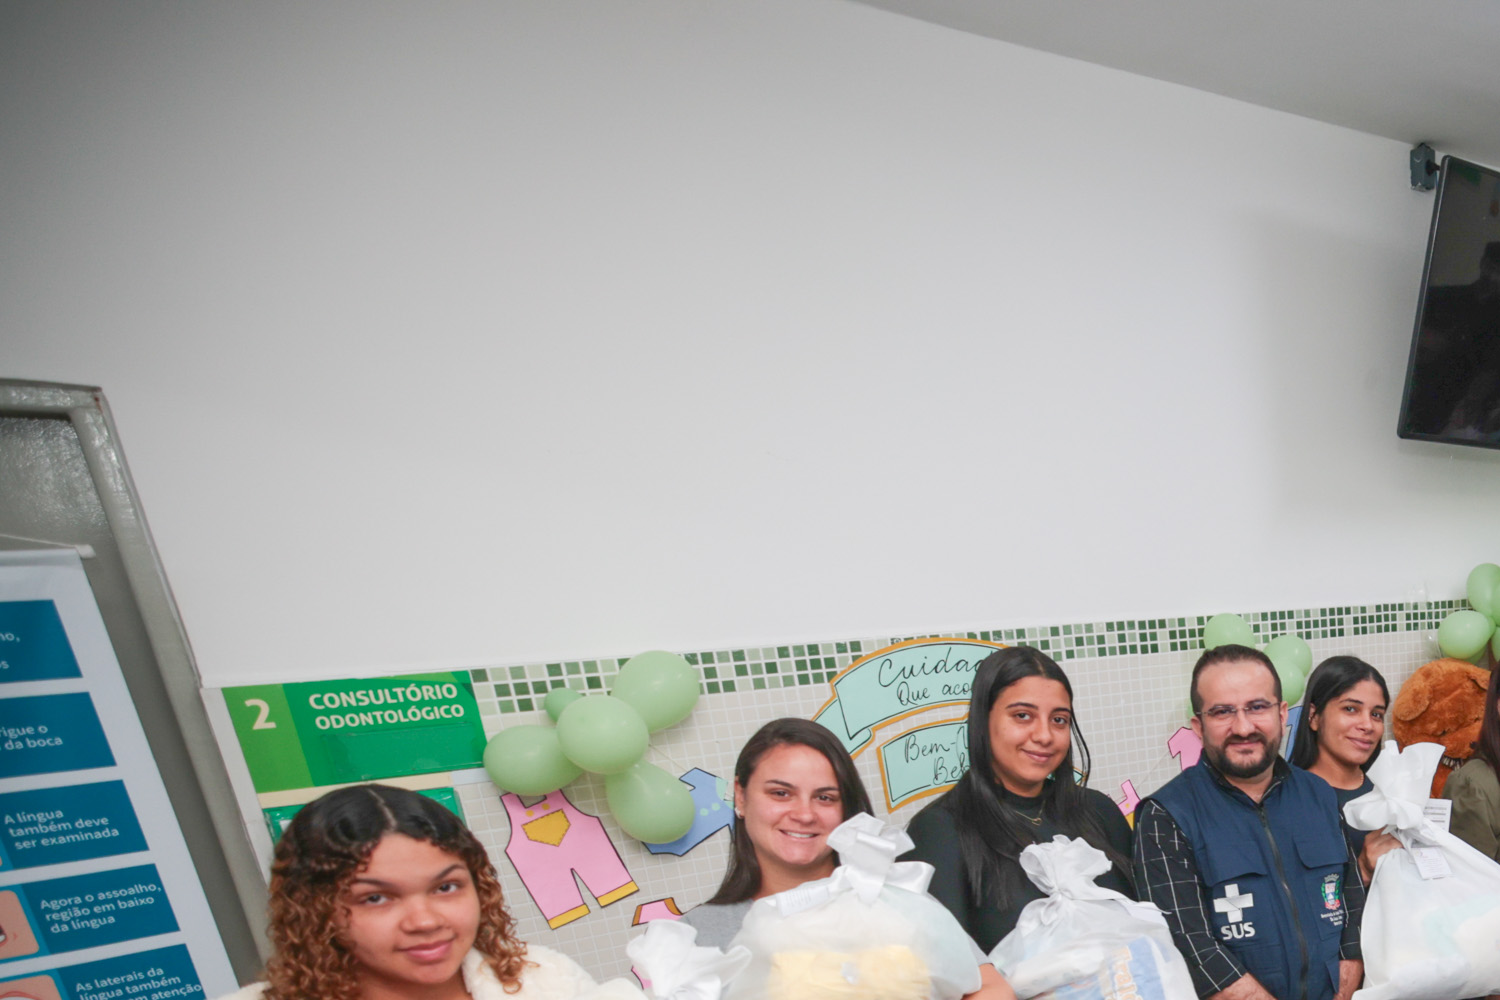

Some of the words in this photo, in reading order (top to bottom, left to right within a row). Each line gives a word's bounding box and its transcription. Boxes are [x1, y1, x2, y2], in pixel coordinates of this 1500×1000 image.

[308, 683, 458, 710] CONSULTÓRIO
[897, 681, 931, 706] Que
[245, 699, 277, 730] 2
[315, 704, 465, 730] ODONTOLÓGICO
[38, 725, 48, 734] o
[4, 739, 24, 750] da
[25, 736, 63, 748] boca
[4, 814, 15, 824] A
[16, 809, 64, 823] língua
[8, 821, 72, 837] também
[74, 817, 109, 829] deve
[15, 839, 37, 850] ser
[40, 828, 120, 846] examinada
[40, 895, 82, 910] Agora
[84, 894, 94, 902] o
[97, 883, 162, 900] assoalho,
[45, 905, 90, 922] região
[93, 903, 116, 914] em
[117, 896, 155, 909] baixo
[50, 923, 69, 933] da
[71, 915, 116, 929] língua
[1220, 921, 1256, 940] SUS
[76, 982, 93, 993] As
[94, 970, 145, 988] laterais
[147, 967, 164, 978] da
[125, 976, 182, 995] também
